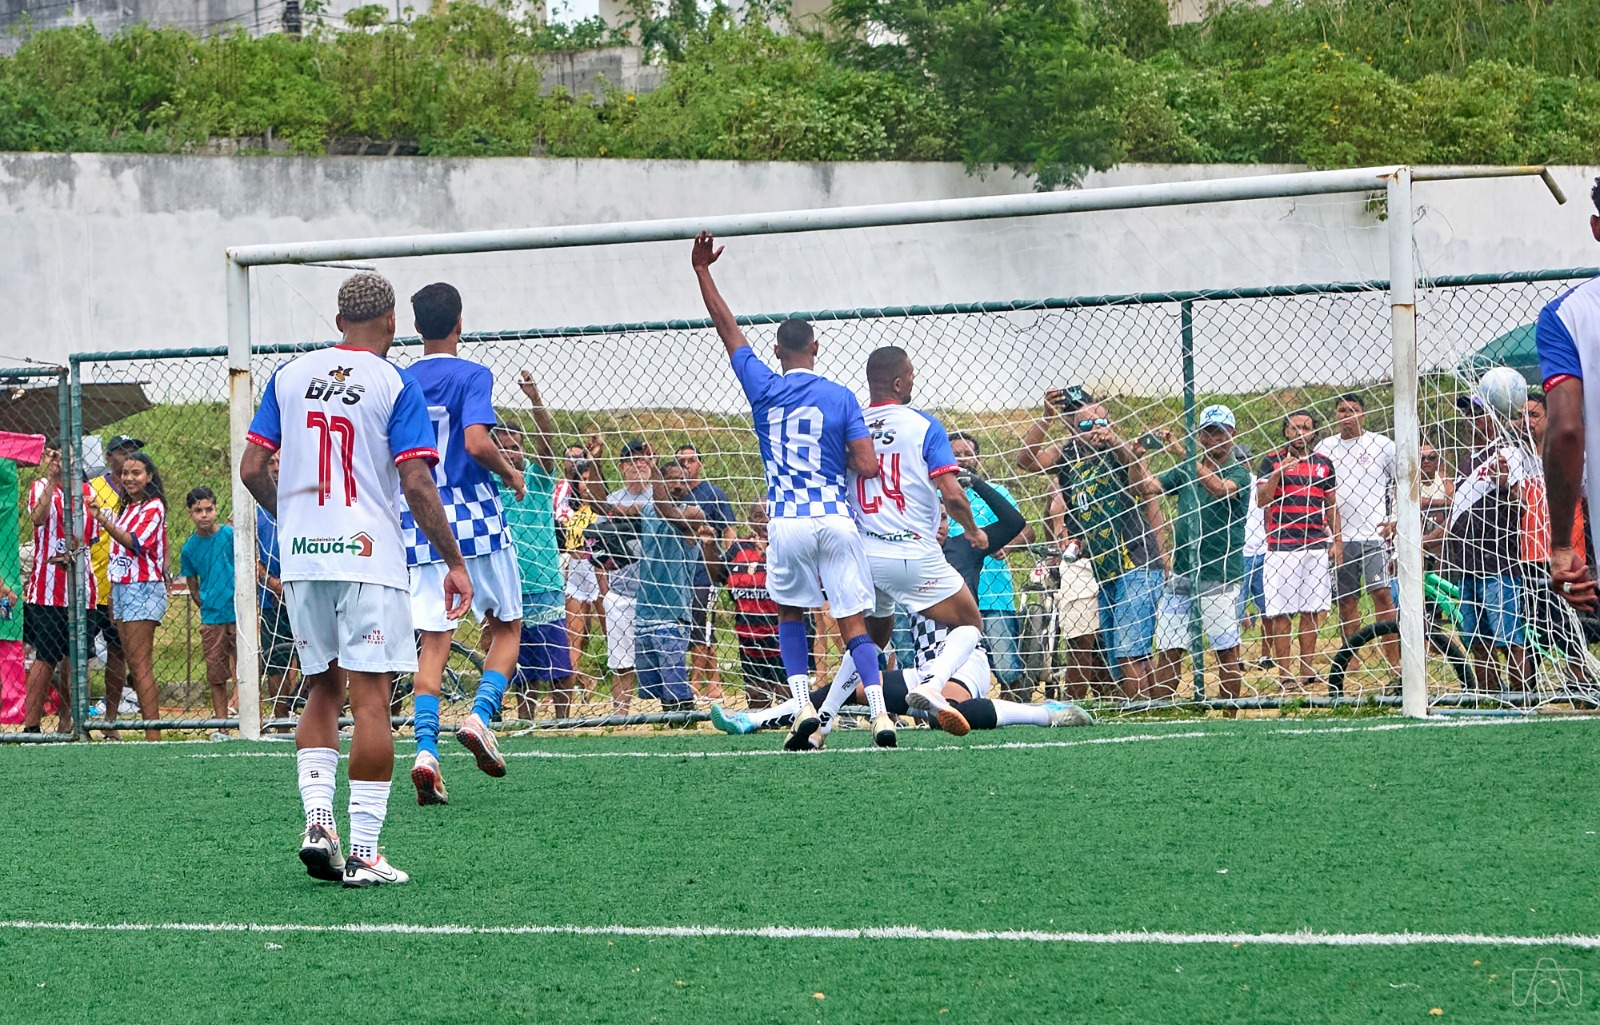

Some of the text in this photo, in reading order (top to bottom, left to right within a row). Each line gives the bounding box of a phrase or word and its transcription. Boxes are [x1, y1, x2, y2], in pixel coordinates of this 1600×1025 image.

[305, 377, 366, 406] BPS
[766, 405, 824, 472] 18
[870, 428, 897, 445] PS
[292, 535, 344, 555] Mauá
